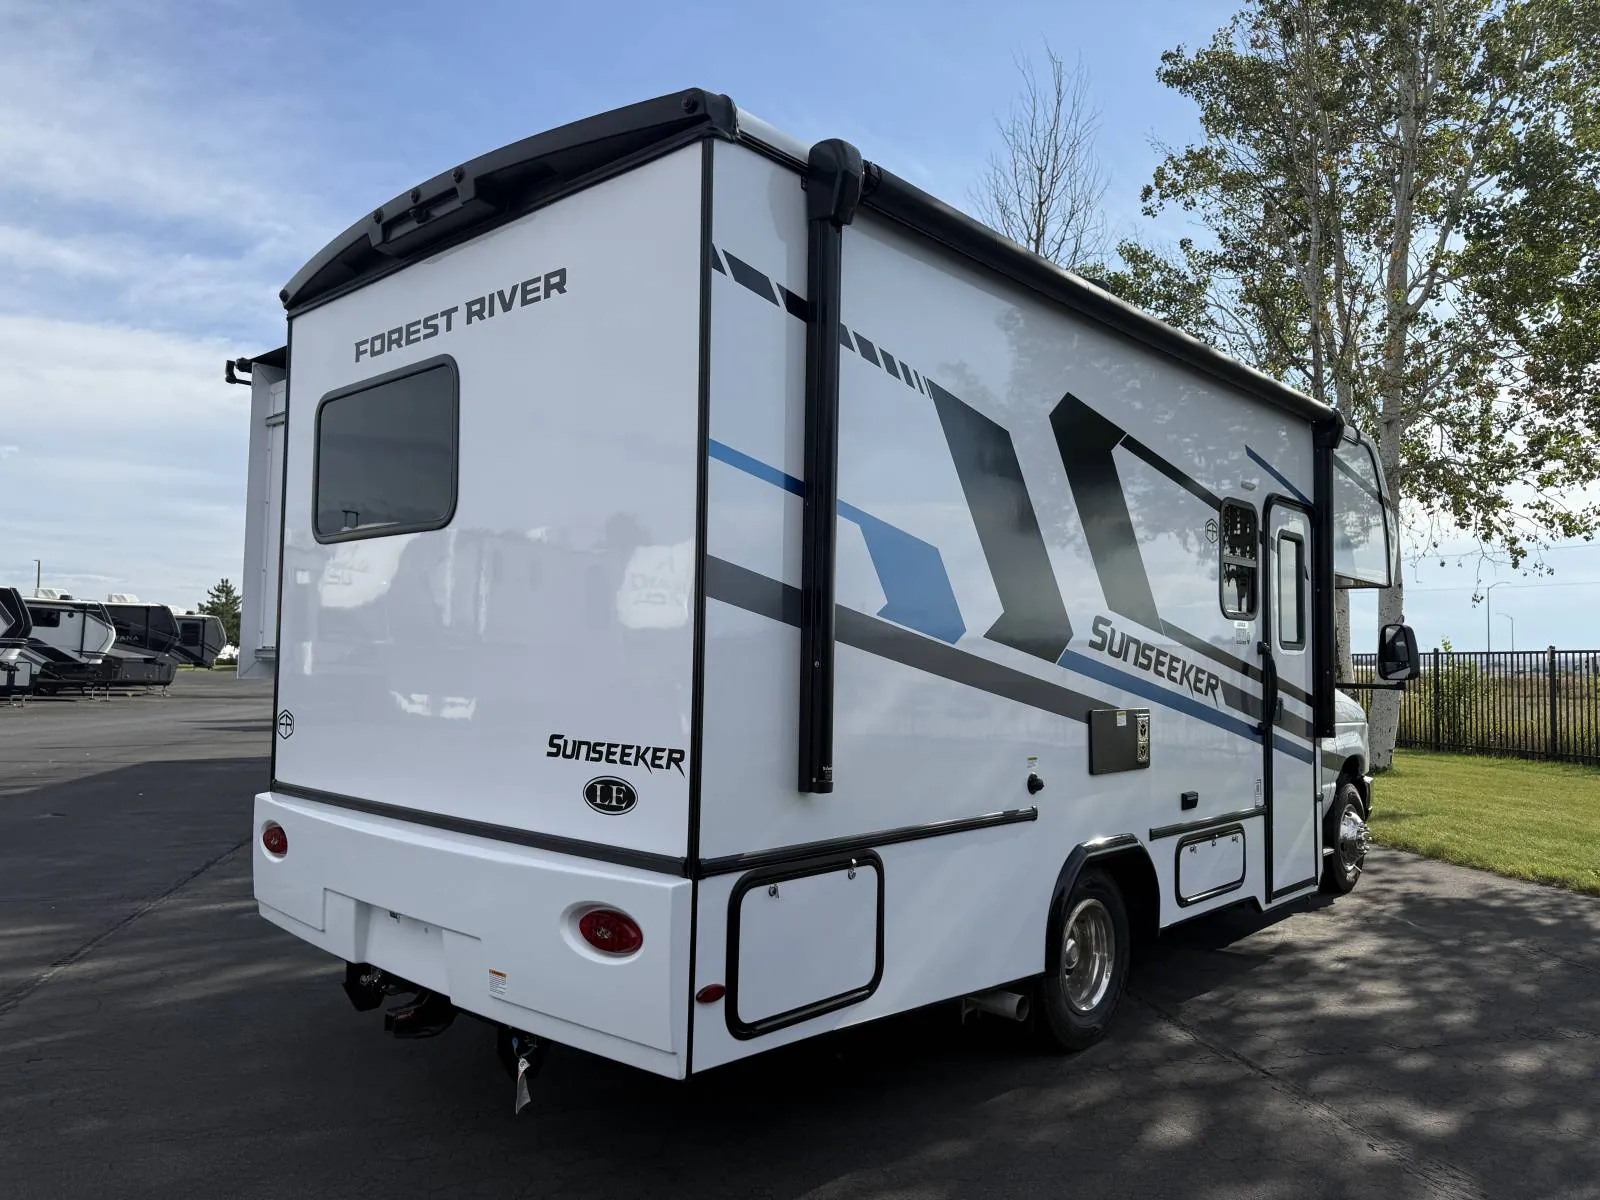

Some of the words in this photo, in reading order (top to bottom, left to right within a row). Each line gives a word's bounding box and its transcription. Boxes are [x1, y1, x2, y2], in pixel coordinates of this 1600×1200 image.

[354, 306, 459, 363] FOREST
[465, 267, 568, 325] RIVER
[593, 783, 627, 809] LE
